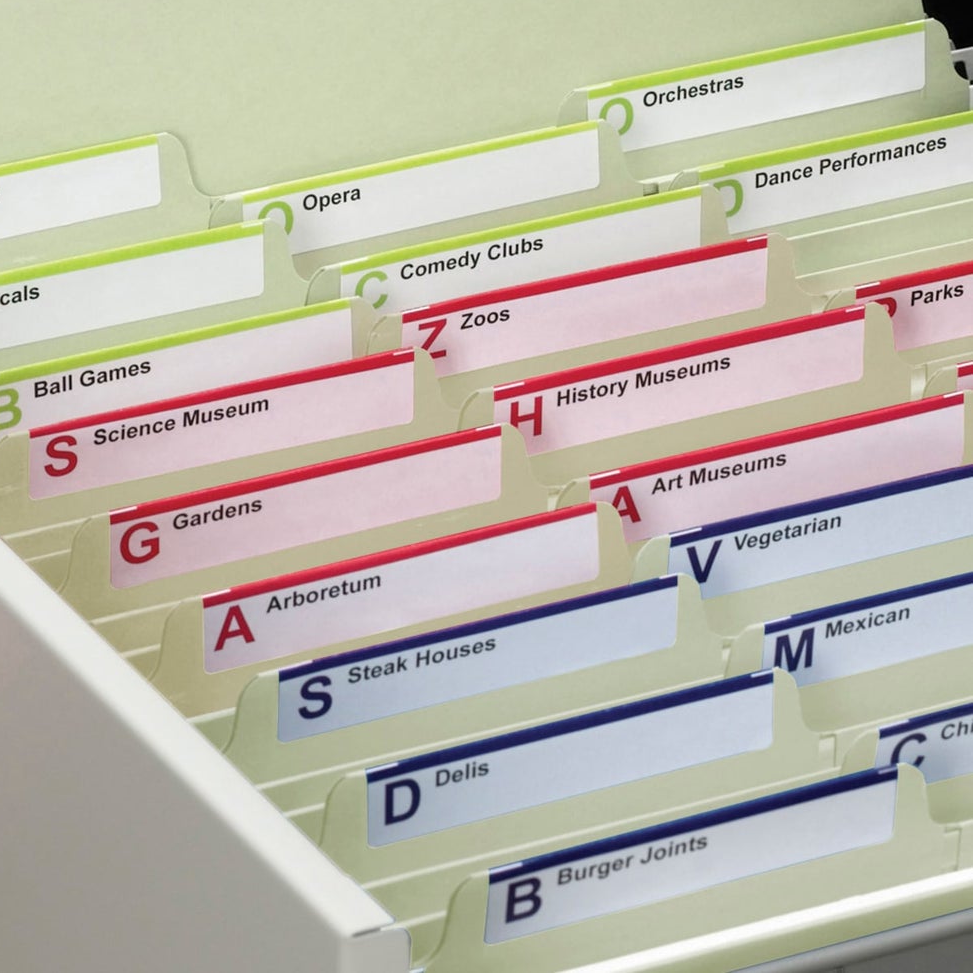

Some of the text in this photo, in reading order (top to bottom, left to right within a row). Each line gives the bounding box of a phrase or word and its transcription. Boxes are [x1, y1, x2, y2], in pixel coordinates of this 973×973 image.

[642, 74, 744, 108] Orchestras
[754, 136, 947, 189] Dance Performances
[302, 188, 361, 212] Opera
[400, 237, 544, 280] Comedy Clubs
[910, 284, 964, 306] Parks
[461, 307, 510, 330] Zoos
[33, 359, 152, 399] Ball Games
[556, 355, 731, 406] History Museums
[93, 397, 269, 445] Science Museum
[509, 396, 543, 437] H
[44, 435, 78, 477] S
[651, 451, 787, 495] Art Museums
[172, 498, 263, 531] Gardens
[612, 487, 641, 523] A
[119, 521, 160, 565] G
[733, 514, 842, 553] Vegetarian
[686, 540, 722, 583] V
[266, 573, 382, 613] Arboretum
[214, 605, 255, 652] A
[825, 605, 911, 639] Mexican
[347, 636, 497, 684] Steak Houses
[772, 628, 815, 672] M
[297, 676, 333, 721] S
[434, 759, 490, 788] Delis
[384, 778, 421, 826] D
[557, 837, 709, 889] Burger Joints
[505, 876, 542, 923] B
